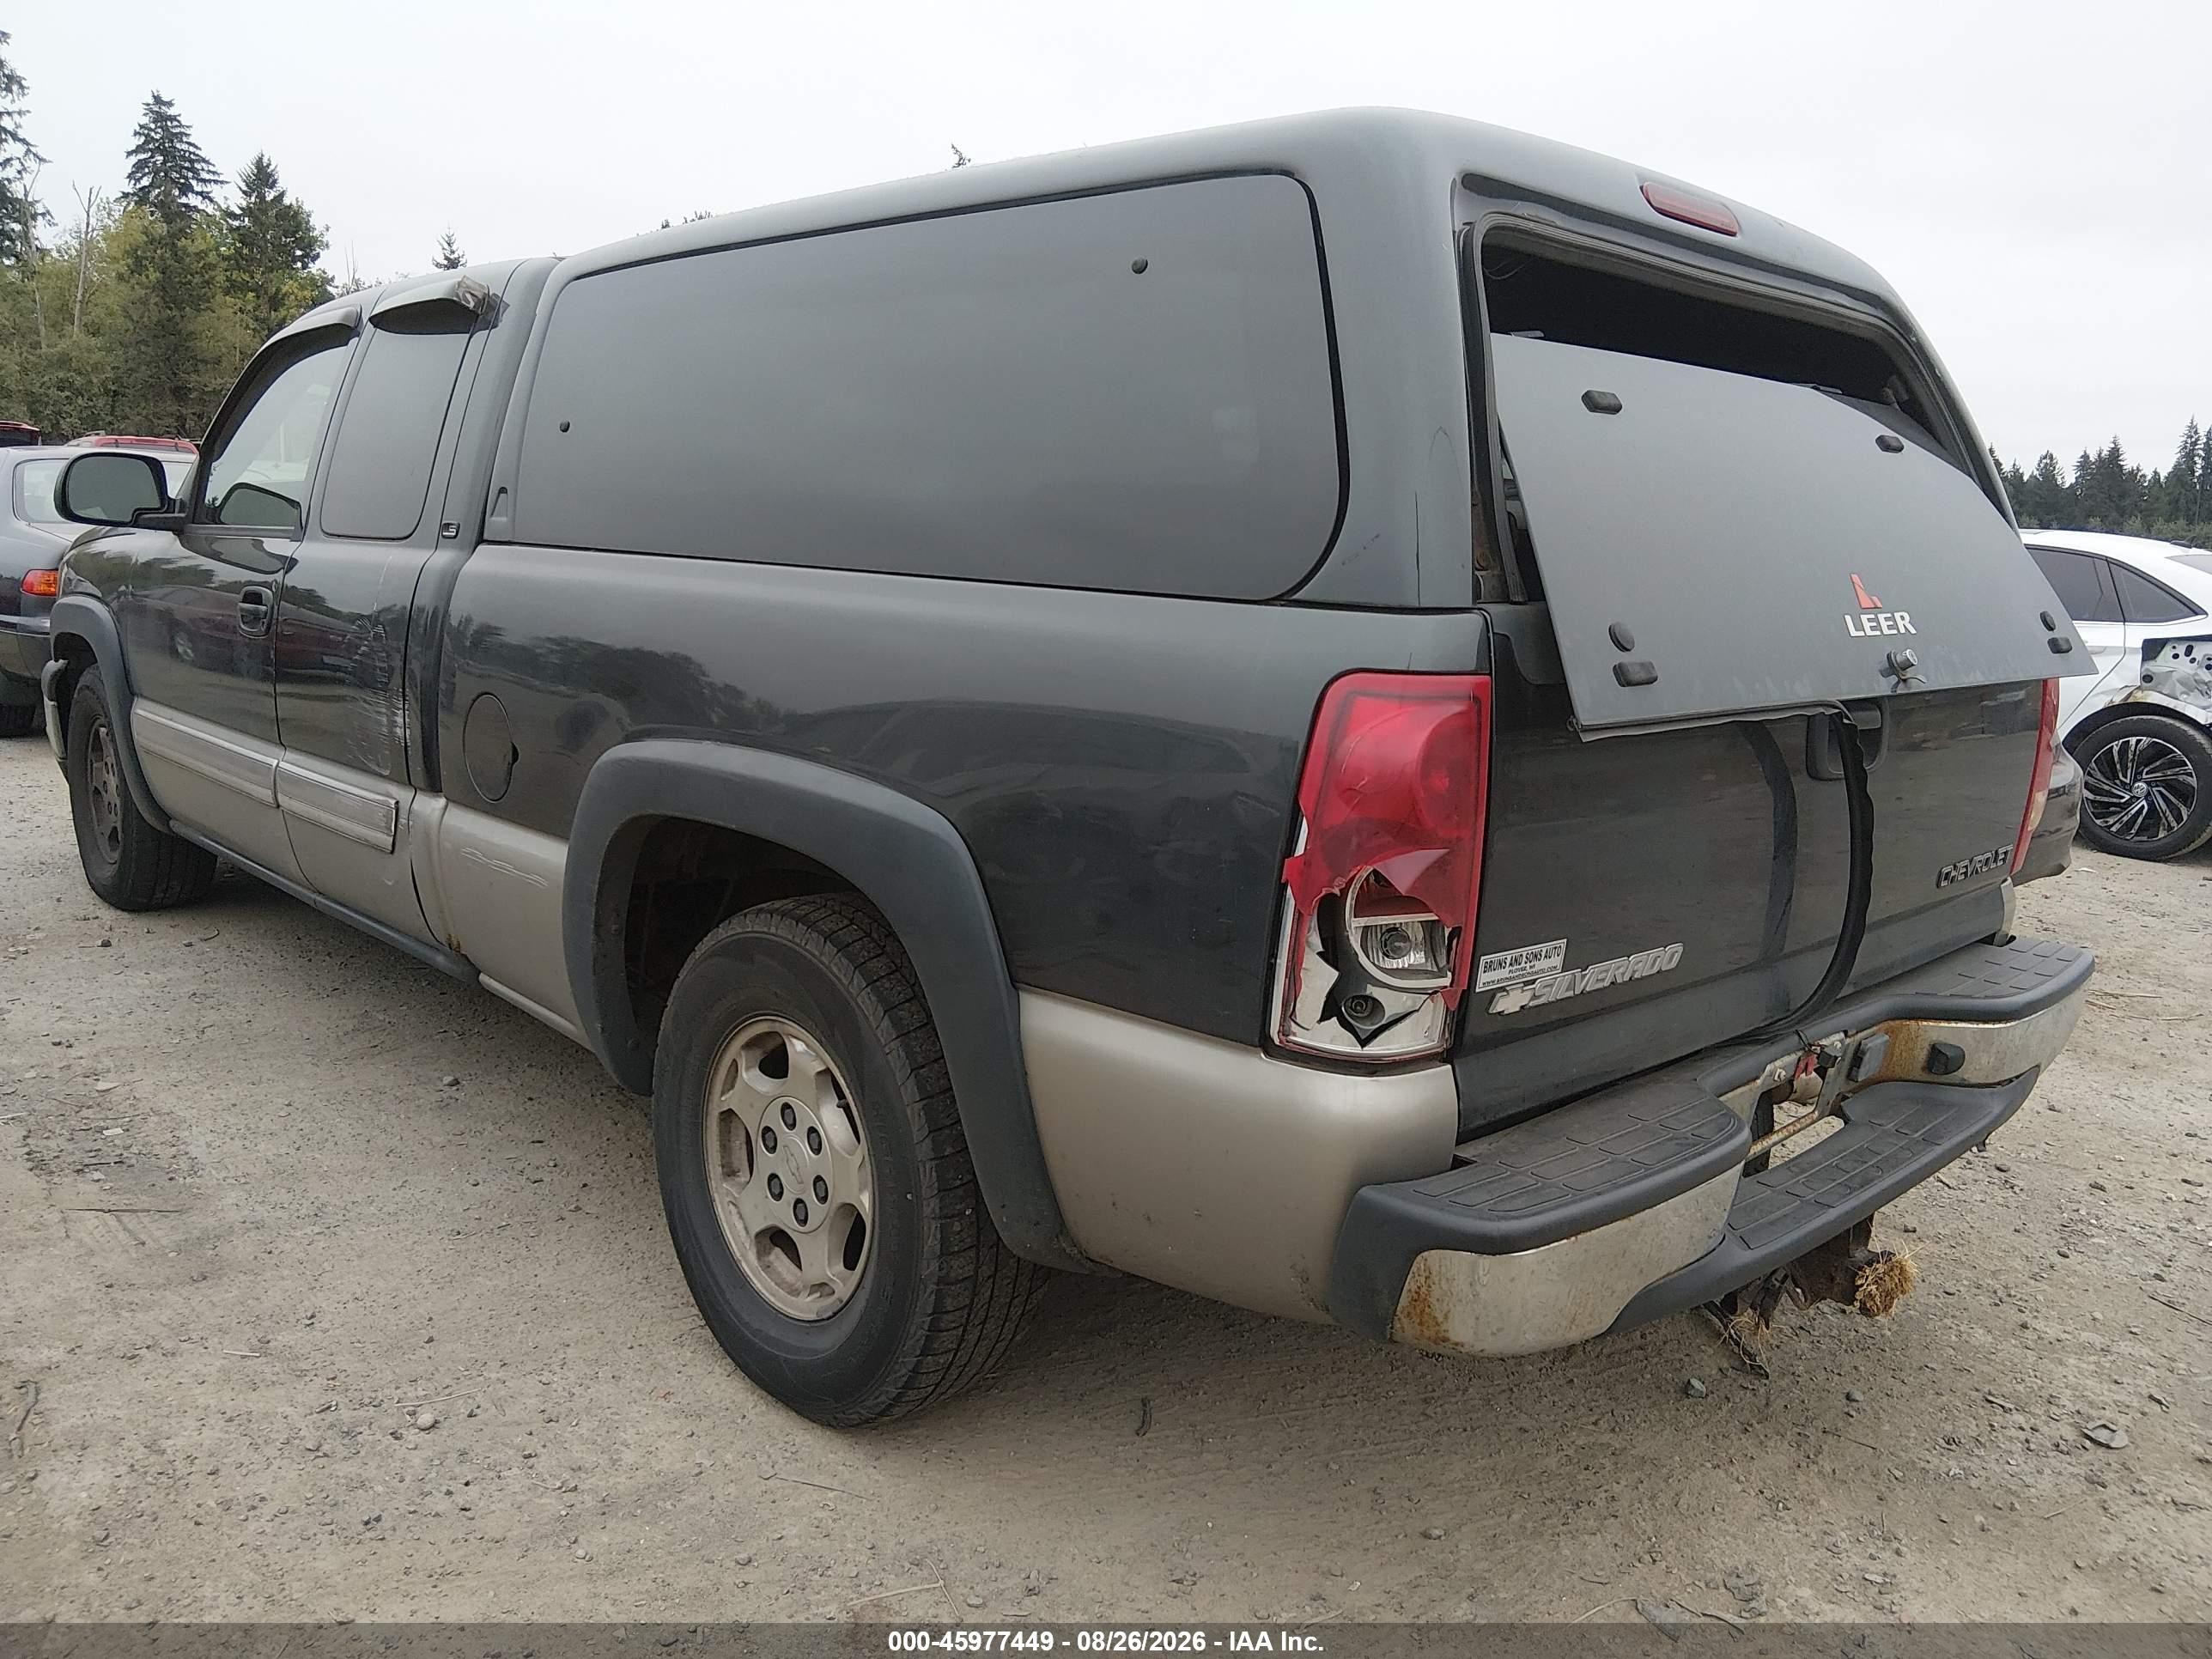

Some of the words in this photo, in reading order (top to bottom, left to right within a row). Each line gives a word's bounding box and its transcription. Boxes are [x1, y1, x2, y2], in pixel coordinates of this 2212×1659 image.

[1844, 611, 1917, 637] LEER
[1938, 844, 2014, 887] CHEVROLET
[1483, 957, 1508, 974] BRUNS
[1509, 953, 1523, 968] AND
[1524, 949, 1543, 964] SONS
[1543, 945, 1562, 960] AUTO
[1529, 943, 1683, 1006] SILVERADO
